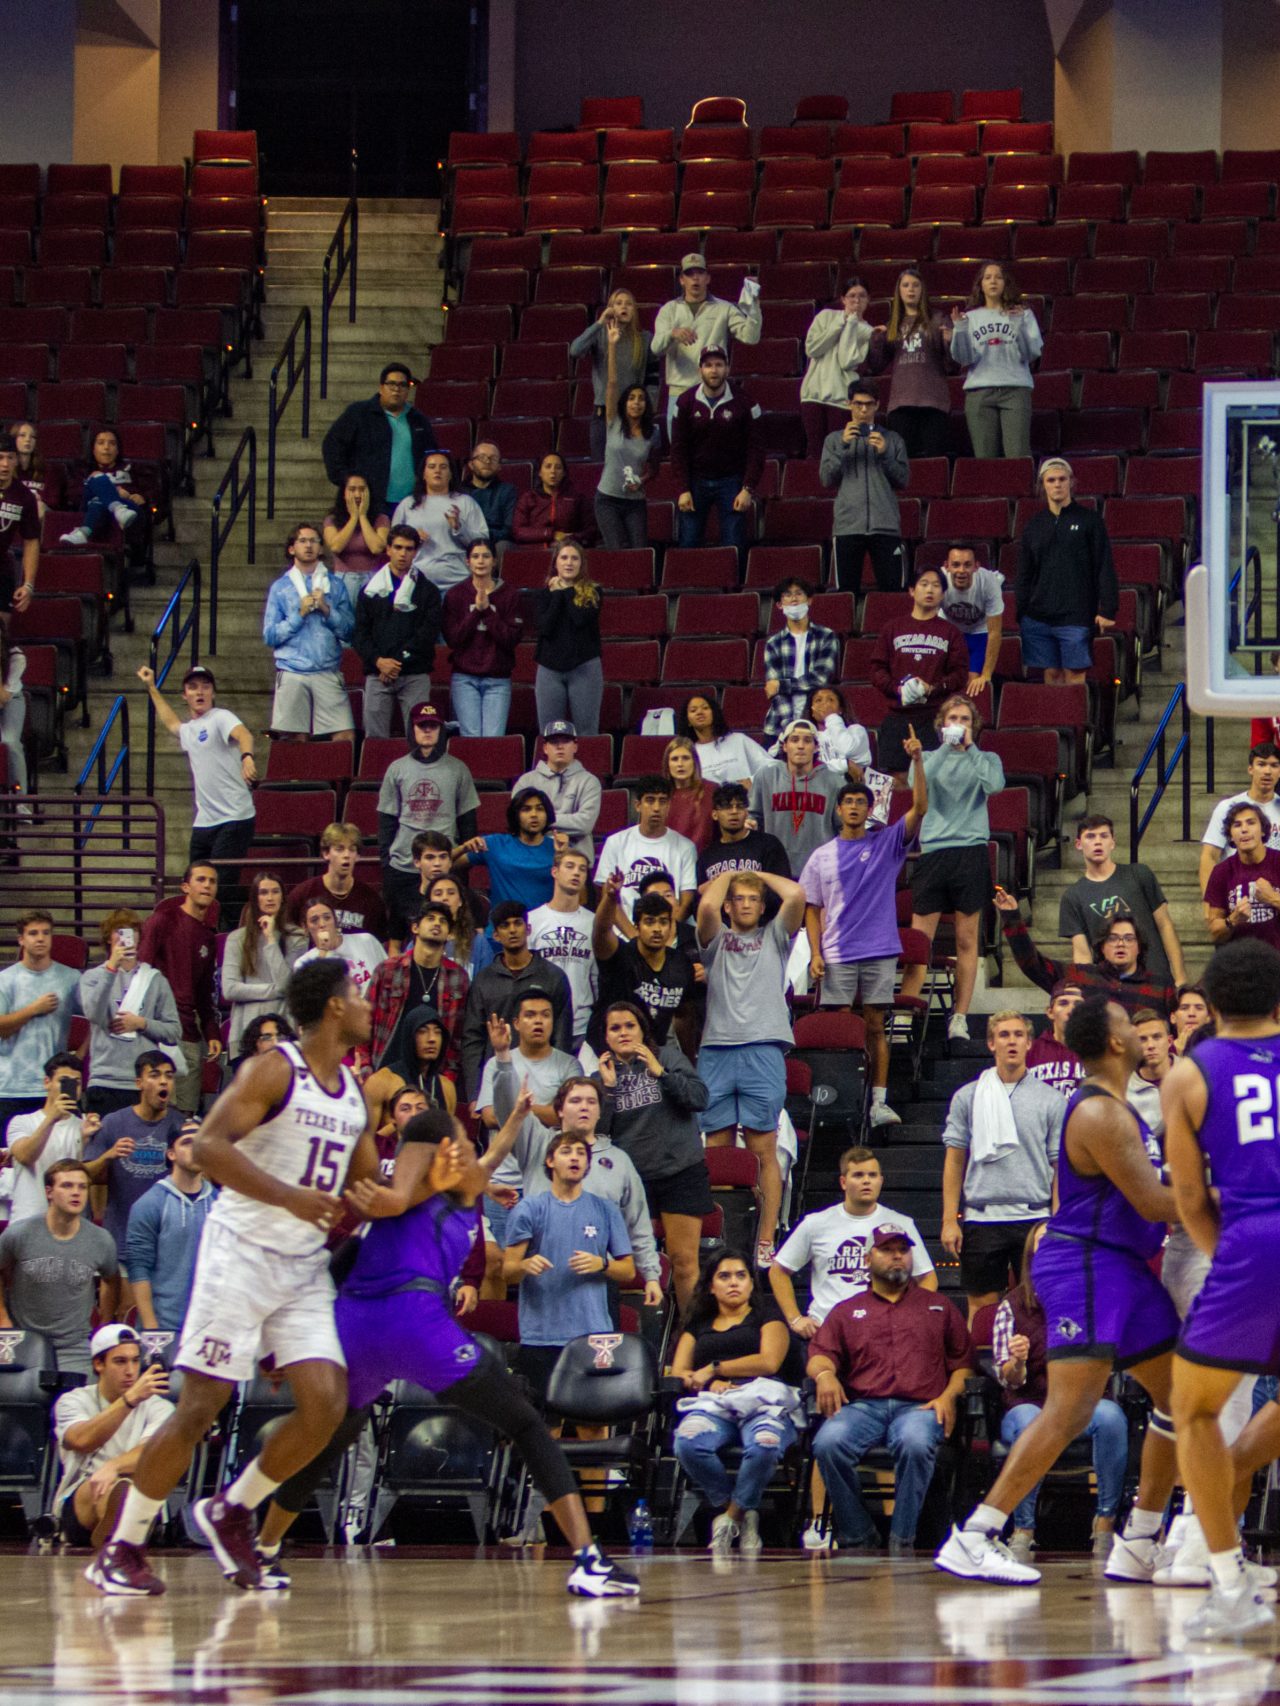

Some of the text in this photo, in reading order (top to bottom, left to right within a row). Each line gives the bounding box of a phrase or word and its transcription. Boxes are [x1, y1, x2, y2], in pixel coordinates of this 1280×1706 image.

[901, 647, 937, 655] UNIVERSITY
[1029, 1061, 1071, 1080] TEXAS
[296, 1108, 338, 1133] TEXAS
[298, 1136, 346, 1193] 15
